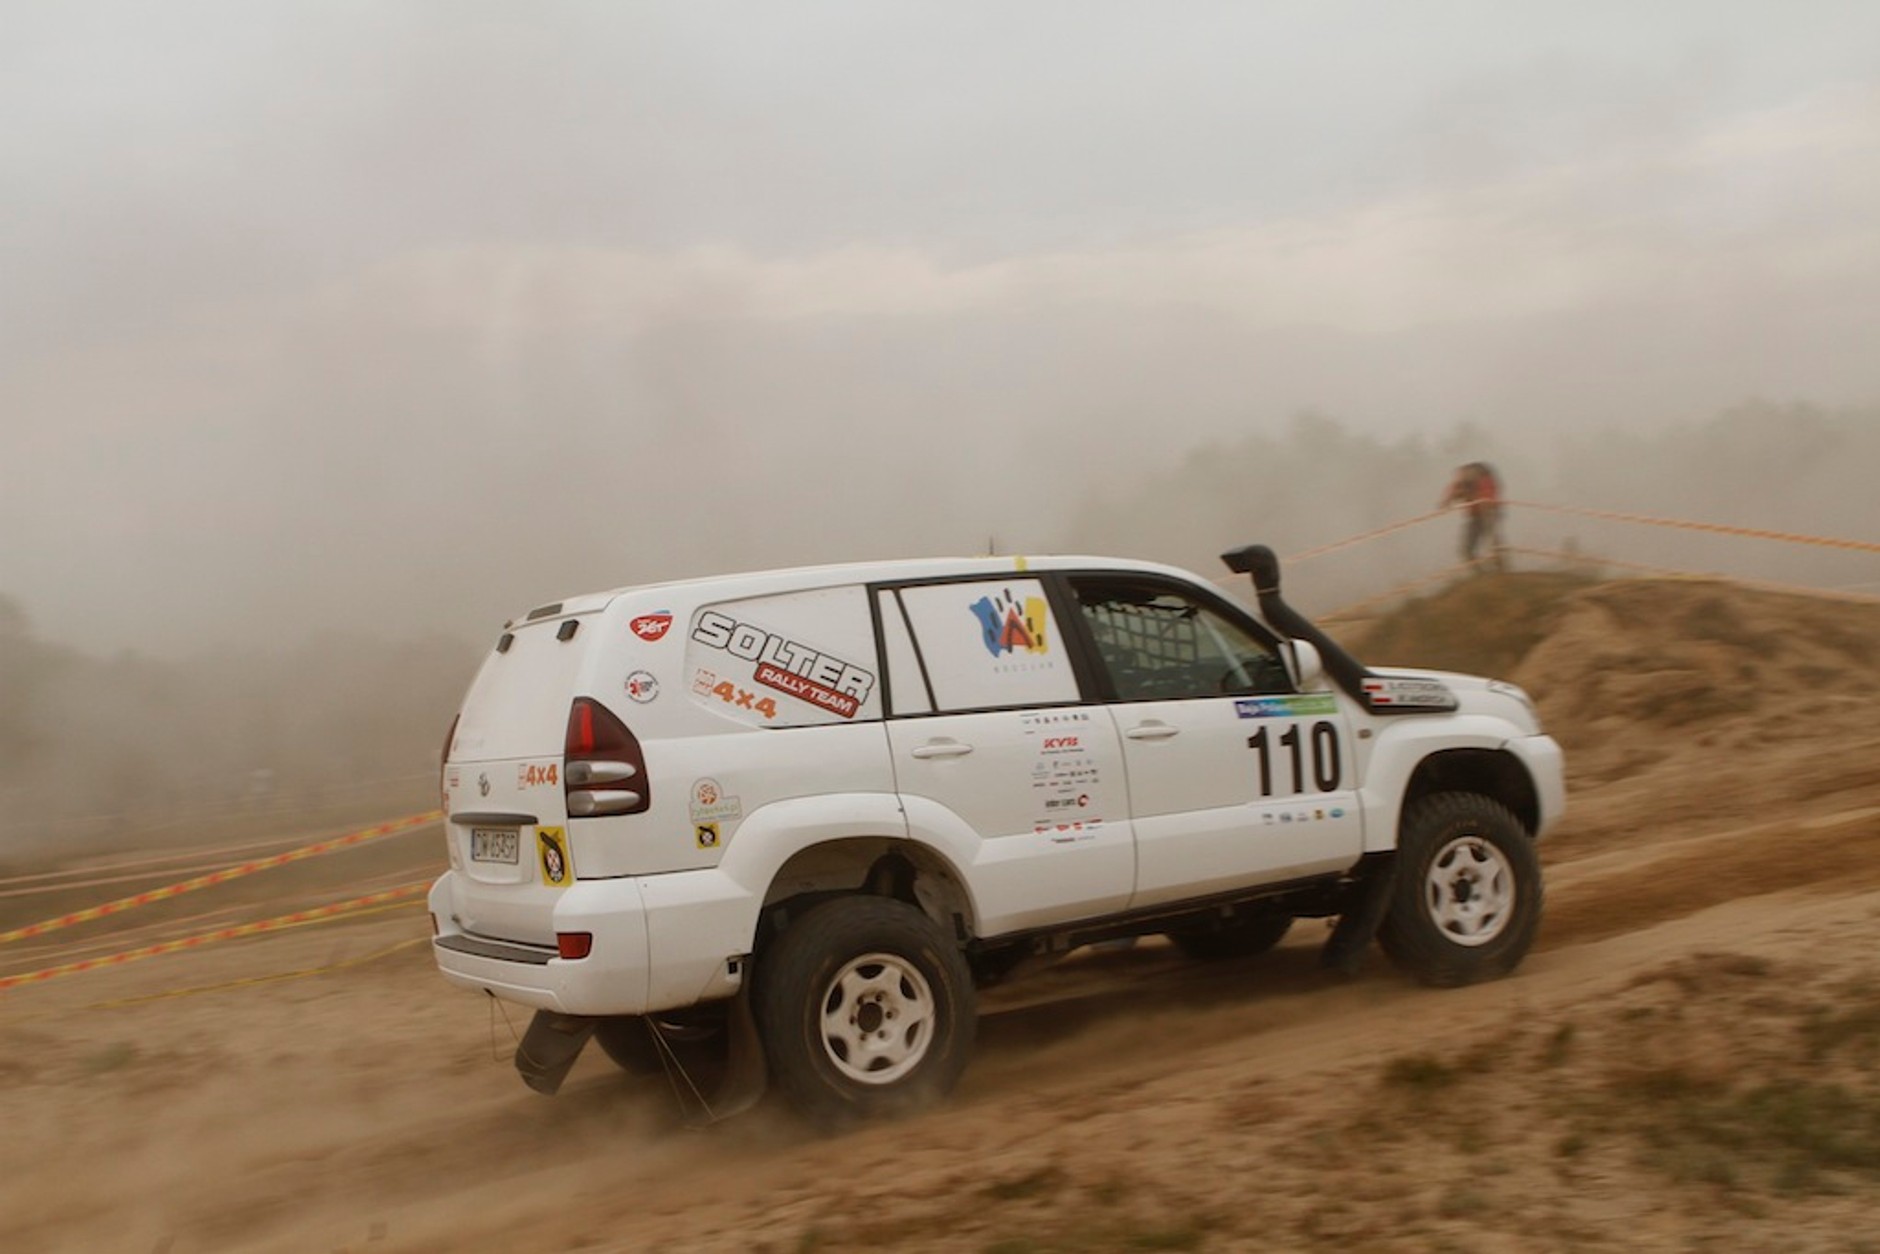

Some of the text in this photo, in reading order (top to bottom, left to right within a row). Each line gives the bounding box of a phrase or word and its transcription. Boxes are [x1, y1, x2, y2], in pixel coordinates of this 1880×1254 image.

[691, 611, 875, 706] SOLTER
[760, 668, 854, 712] RALLY TEAM
[1044, 737, 1079, 748] KYB
[1247, 721, 1341, 796] 110
